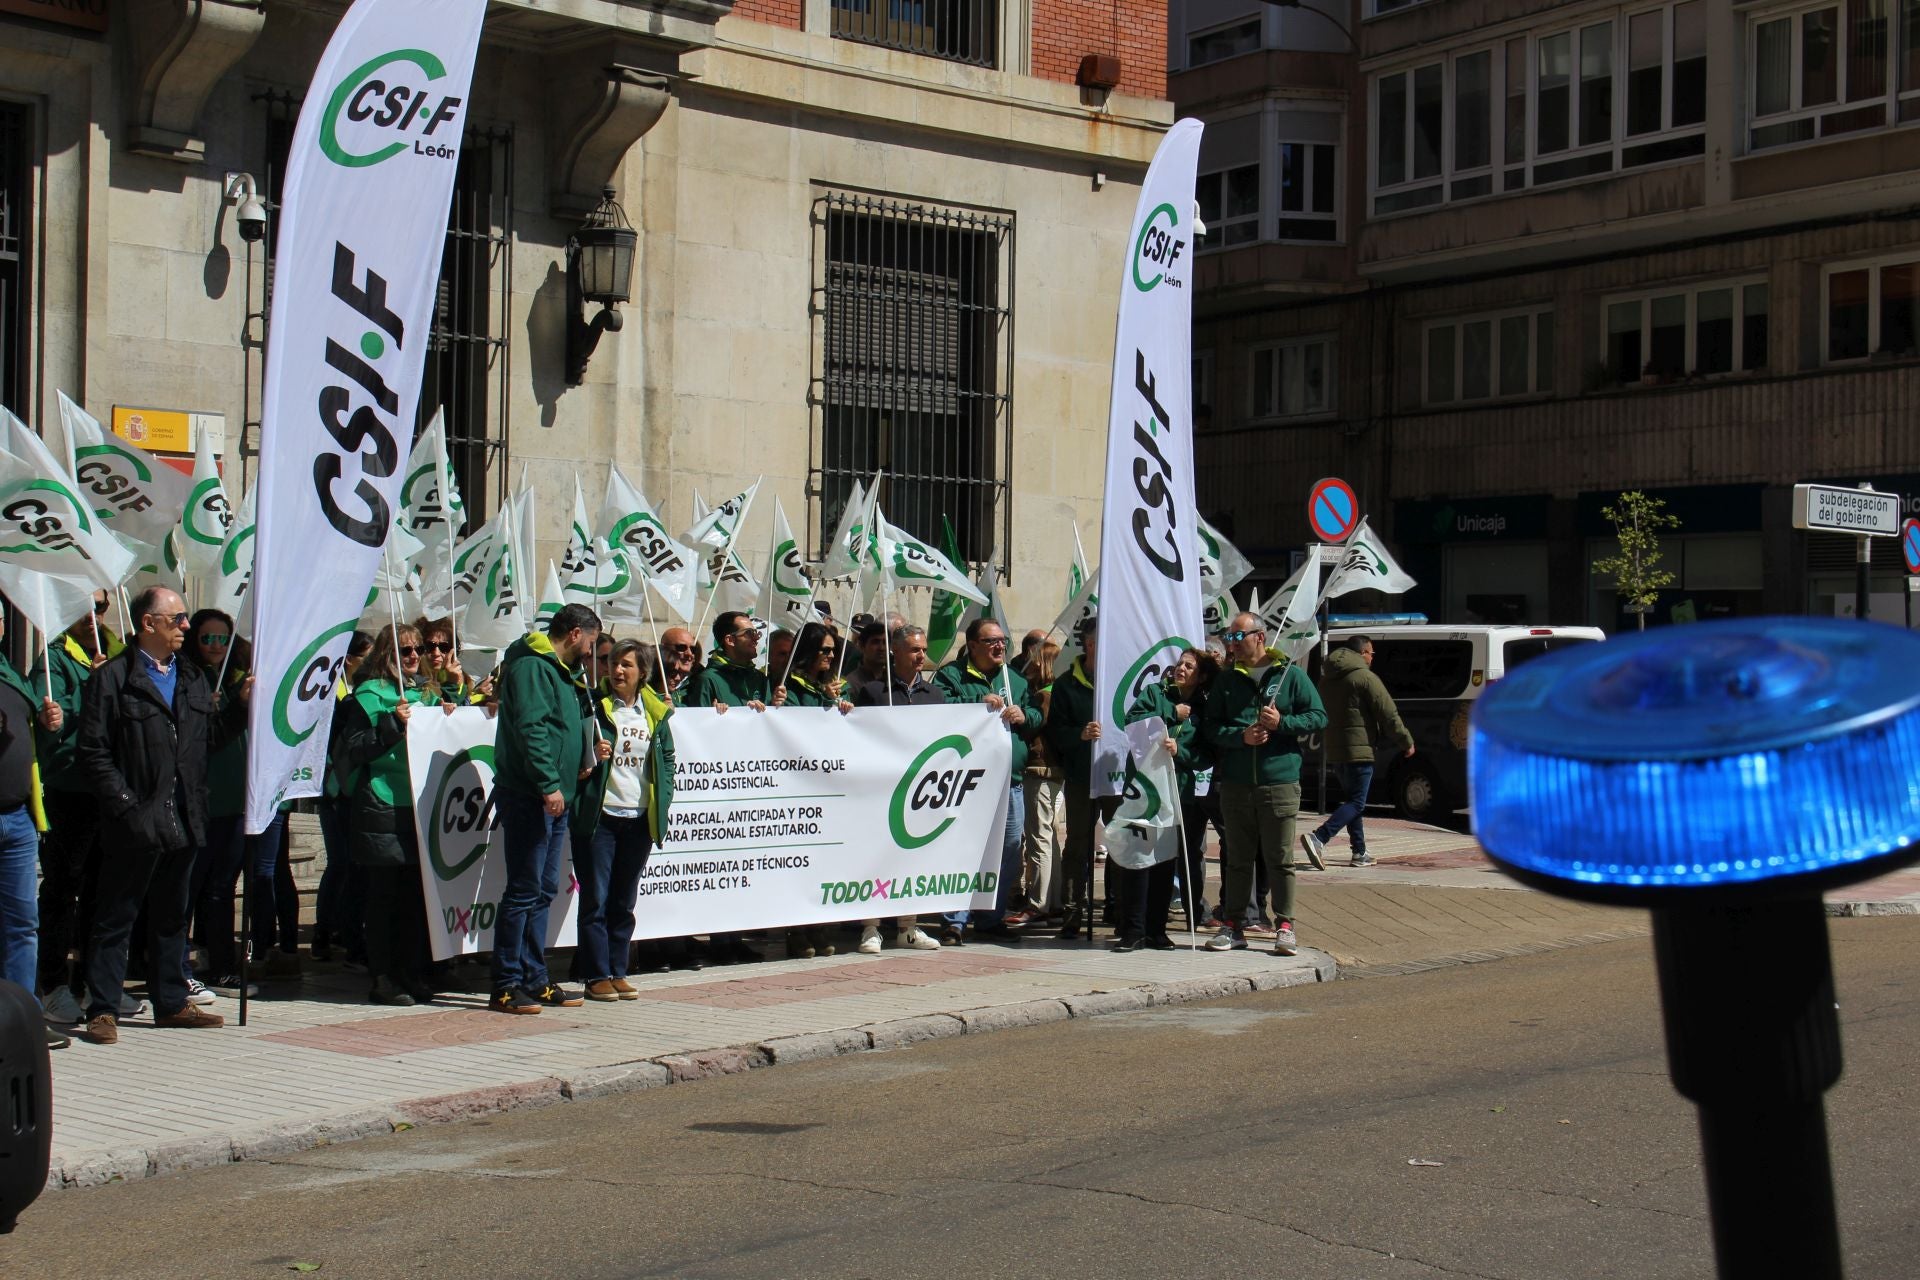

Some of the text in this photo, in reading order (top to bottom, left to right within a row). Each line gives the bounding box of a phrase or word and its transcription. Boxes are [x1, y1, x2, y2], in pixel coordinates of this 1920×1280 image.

[414, 140, 455, 160] León
[1165, 272, 1182, 288] León
[77, 462, 153, 513] CSIF
[1819, 491, 1888, 513] subdelegación
[1456, 513, 1507, 535] Unicaja
[1818, 507, 1878, 526] del gobierno
[2, 498, 92, 560] CSIF
[624, 526, 684, 575] CSIF
[708, 548, 749, 583] SIF
[688, 761, 723, 775] TODAS
[726, 760, 746, 773] LAS
[747, 756, 818, 773] CATEGORÍAS
[821, 759, 846, 774] QUE
[712, 776, 779, 791] ASISTENCIAL.
[911, 768, 986, 811] CSIF
[676, 811, 725, 826] PARCIAL,
[727, 808, 786, 824] ANTICIPADA
[786, 807, 795, 820] Y
[798, 806, 823, 819] POR
[691, 827, 747, 842] PERSONAL
[749, 823, 822, 838] ESTATUTARIO.
[682, 860, 740, 876] INMEDIATA
[742, 858, 754, 872] DE
[756, 854, 810, 871] TÉCNICOS
[639, 878, 700, 896] SUPERIORES
[703, 877, 716, 891] AL
[731, 876, 739, 888] Y
[741, 876, 751, 889] B.
